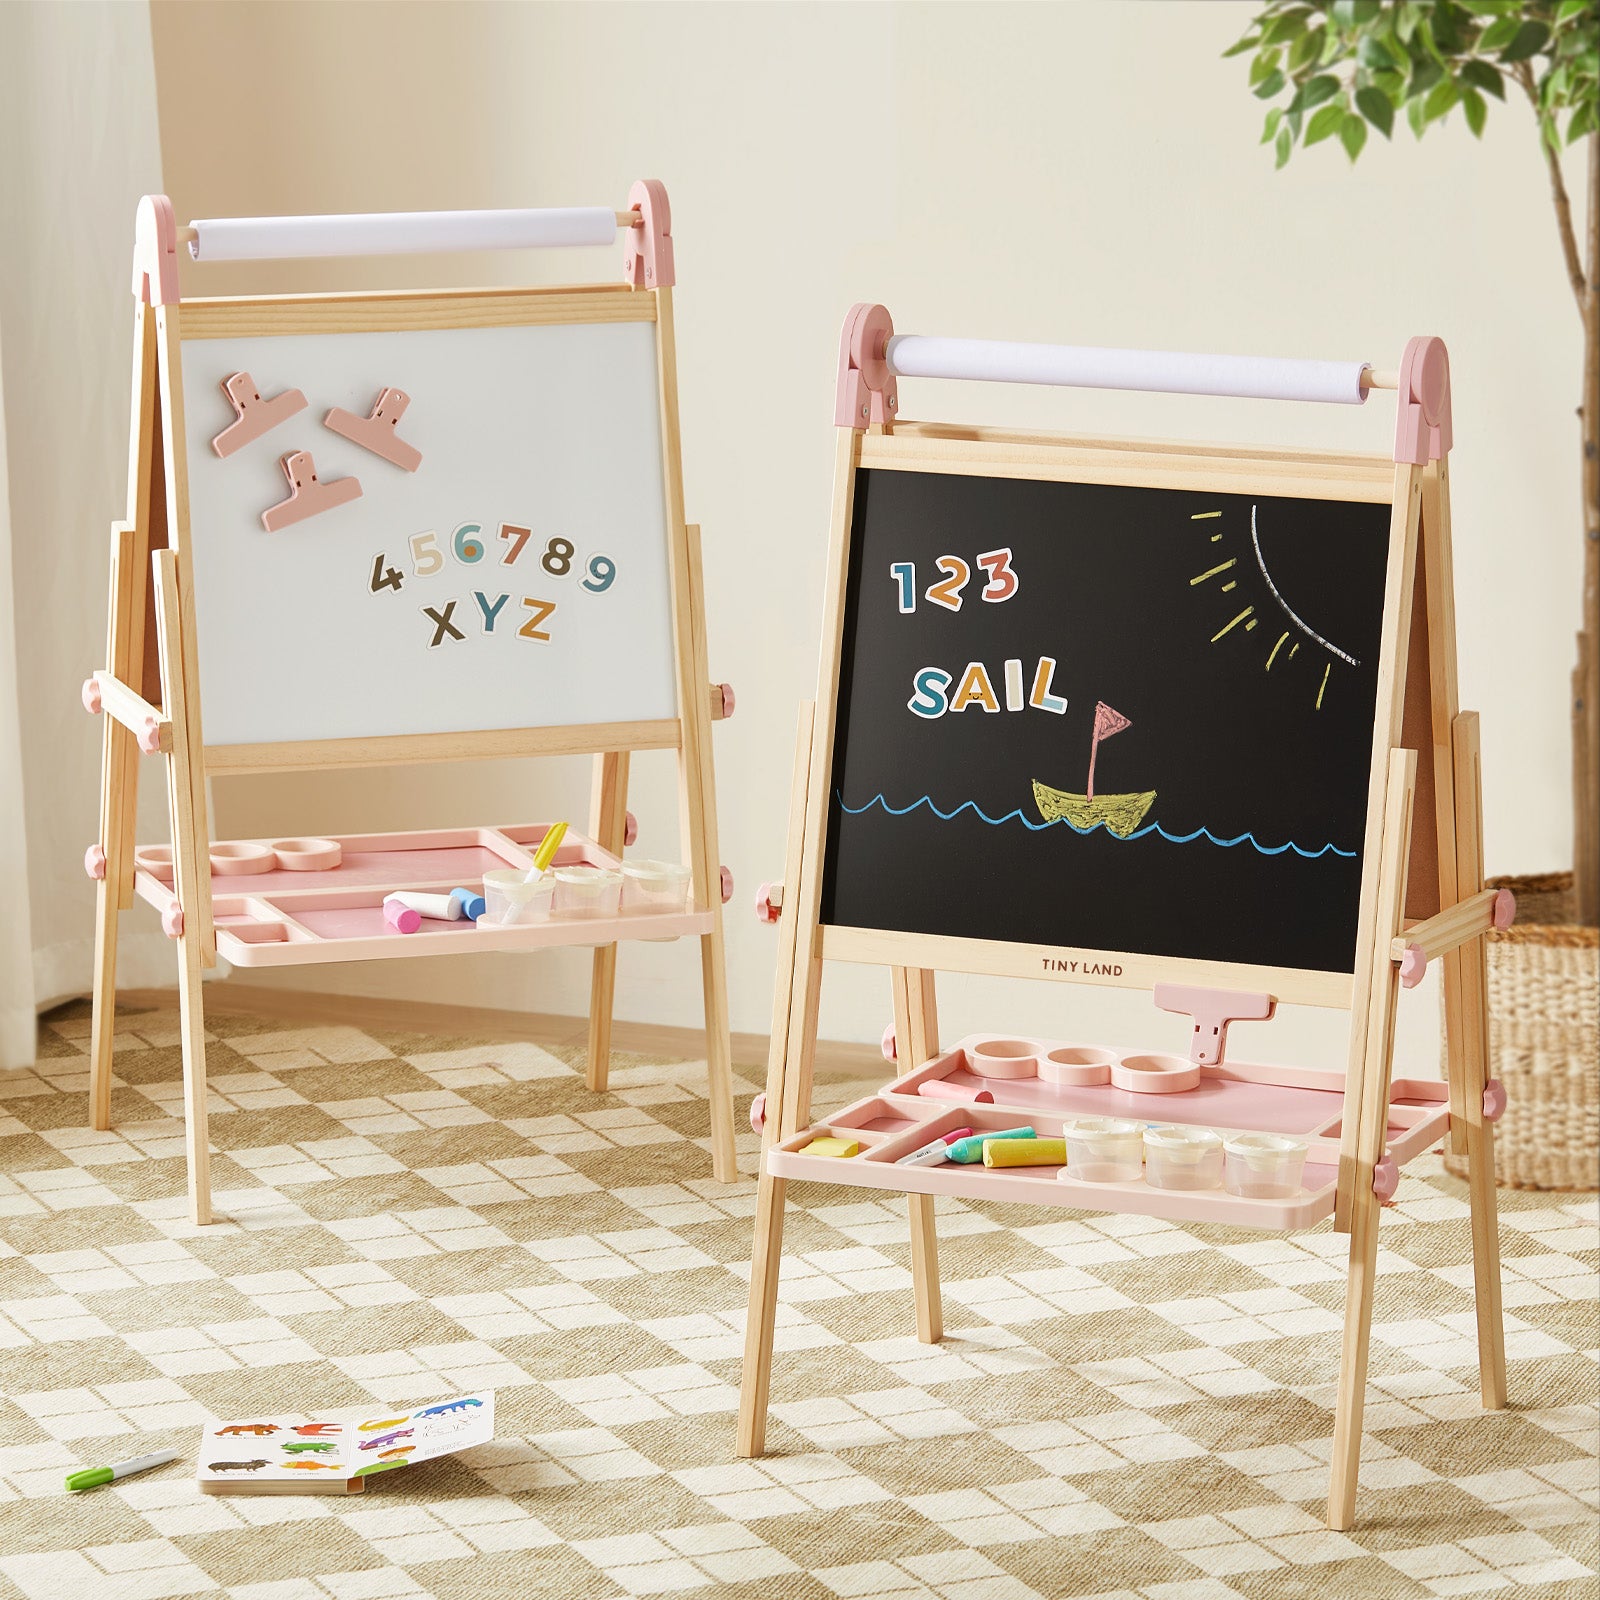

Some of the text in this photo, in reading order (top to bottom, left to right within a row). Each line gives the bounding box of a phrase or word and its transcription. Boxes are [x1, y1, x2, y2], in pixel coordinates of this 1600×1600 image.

[422, 590, 558, 649] XYZ
[909, 657, 1066, 718] SAIL
[1042, 958, 1123, 977] TINY LAND
